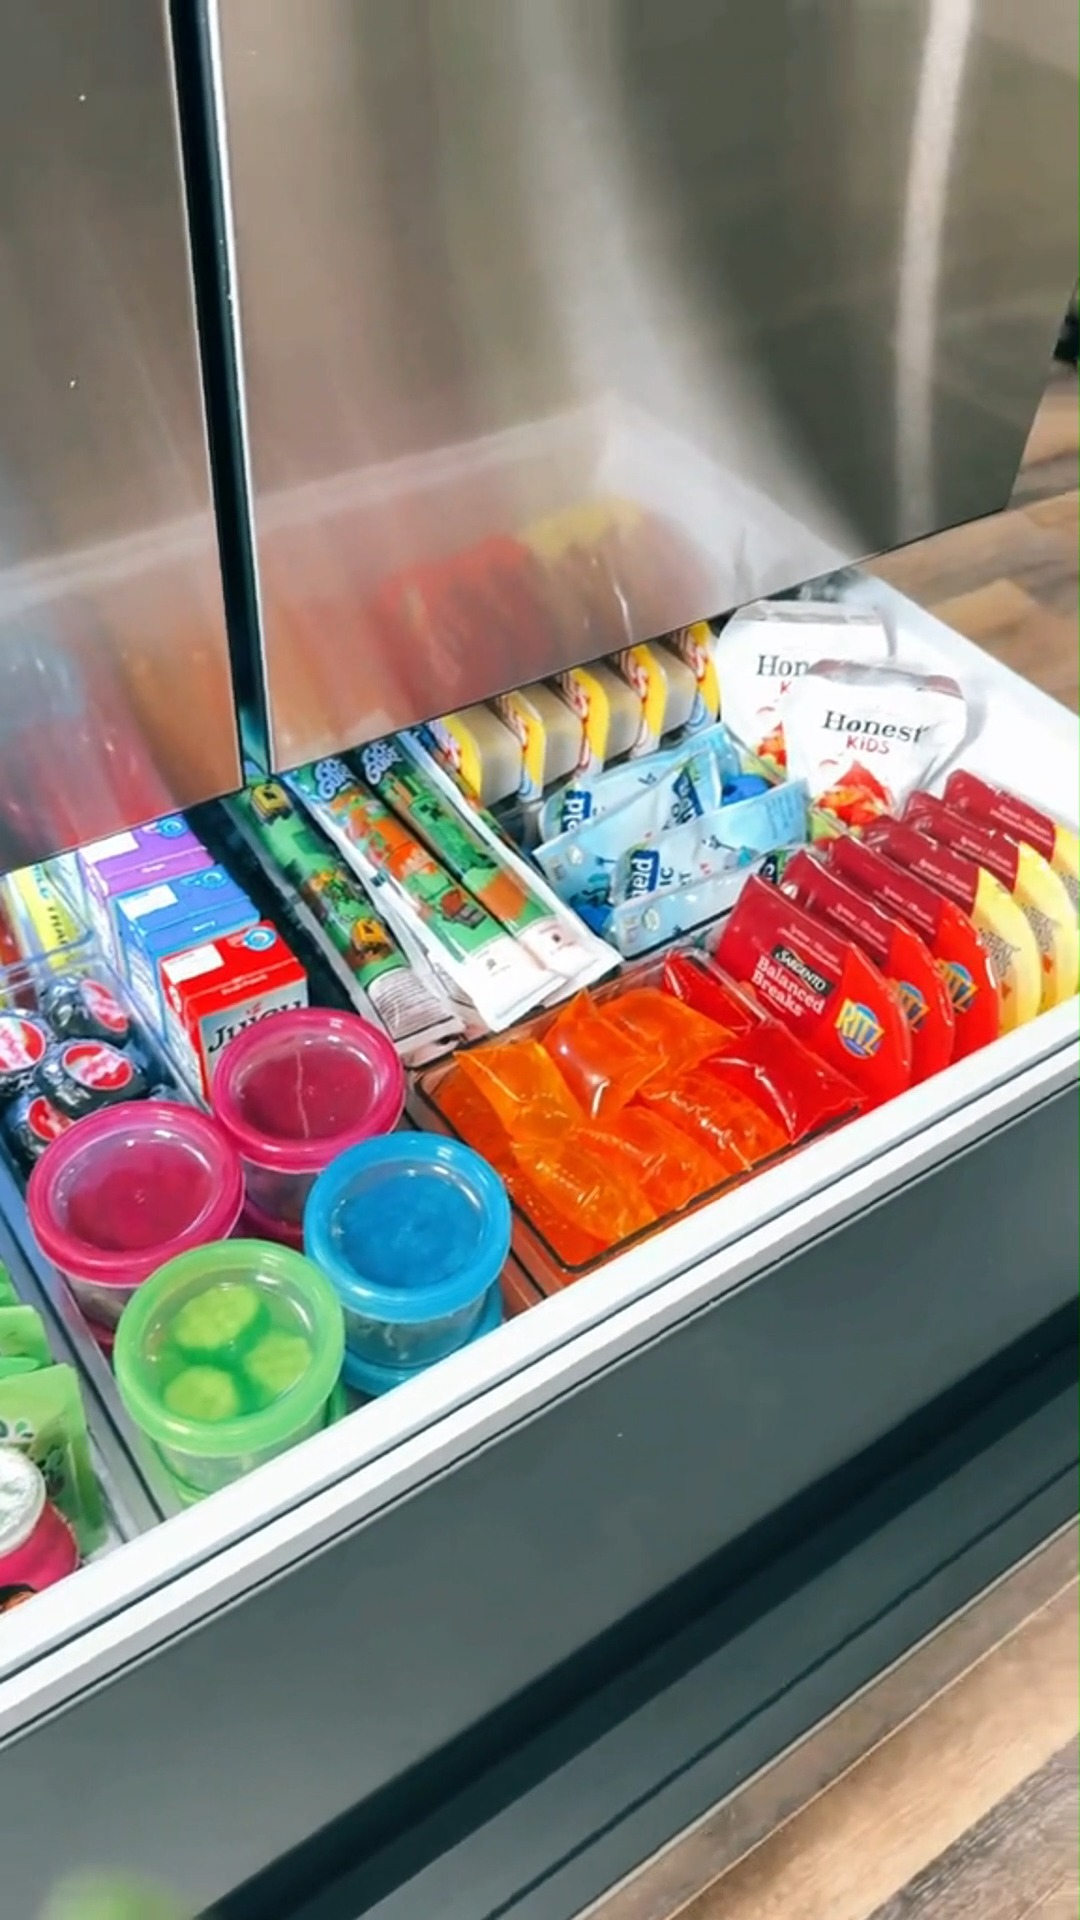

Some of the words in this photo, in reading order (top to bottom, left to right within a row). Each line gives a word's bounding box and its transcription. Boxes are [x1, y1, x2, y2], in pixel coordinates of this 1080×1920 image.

[822, 709, 925, 744] Honest
[750, 968, 804, 1017] Breaks
[756, 955, 826, 1016] Balanced
[774, 950, 827, 993] SARGENTO
[834, 998, 885, 1057] RITZ
